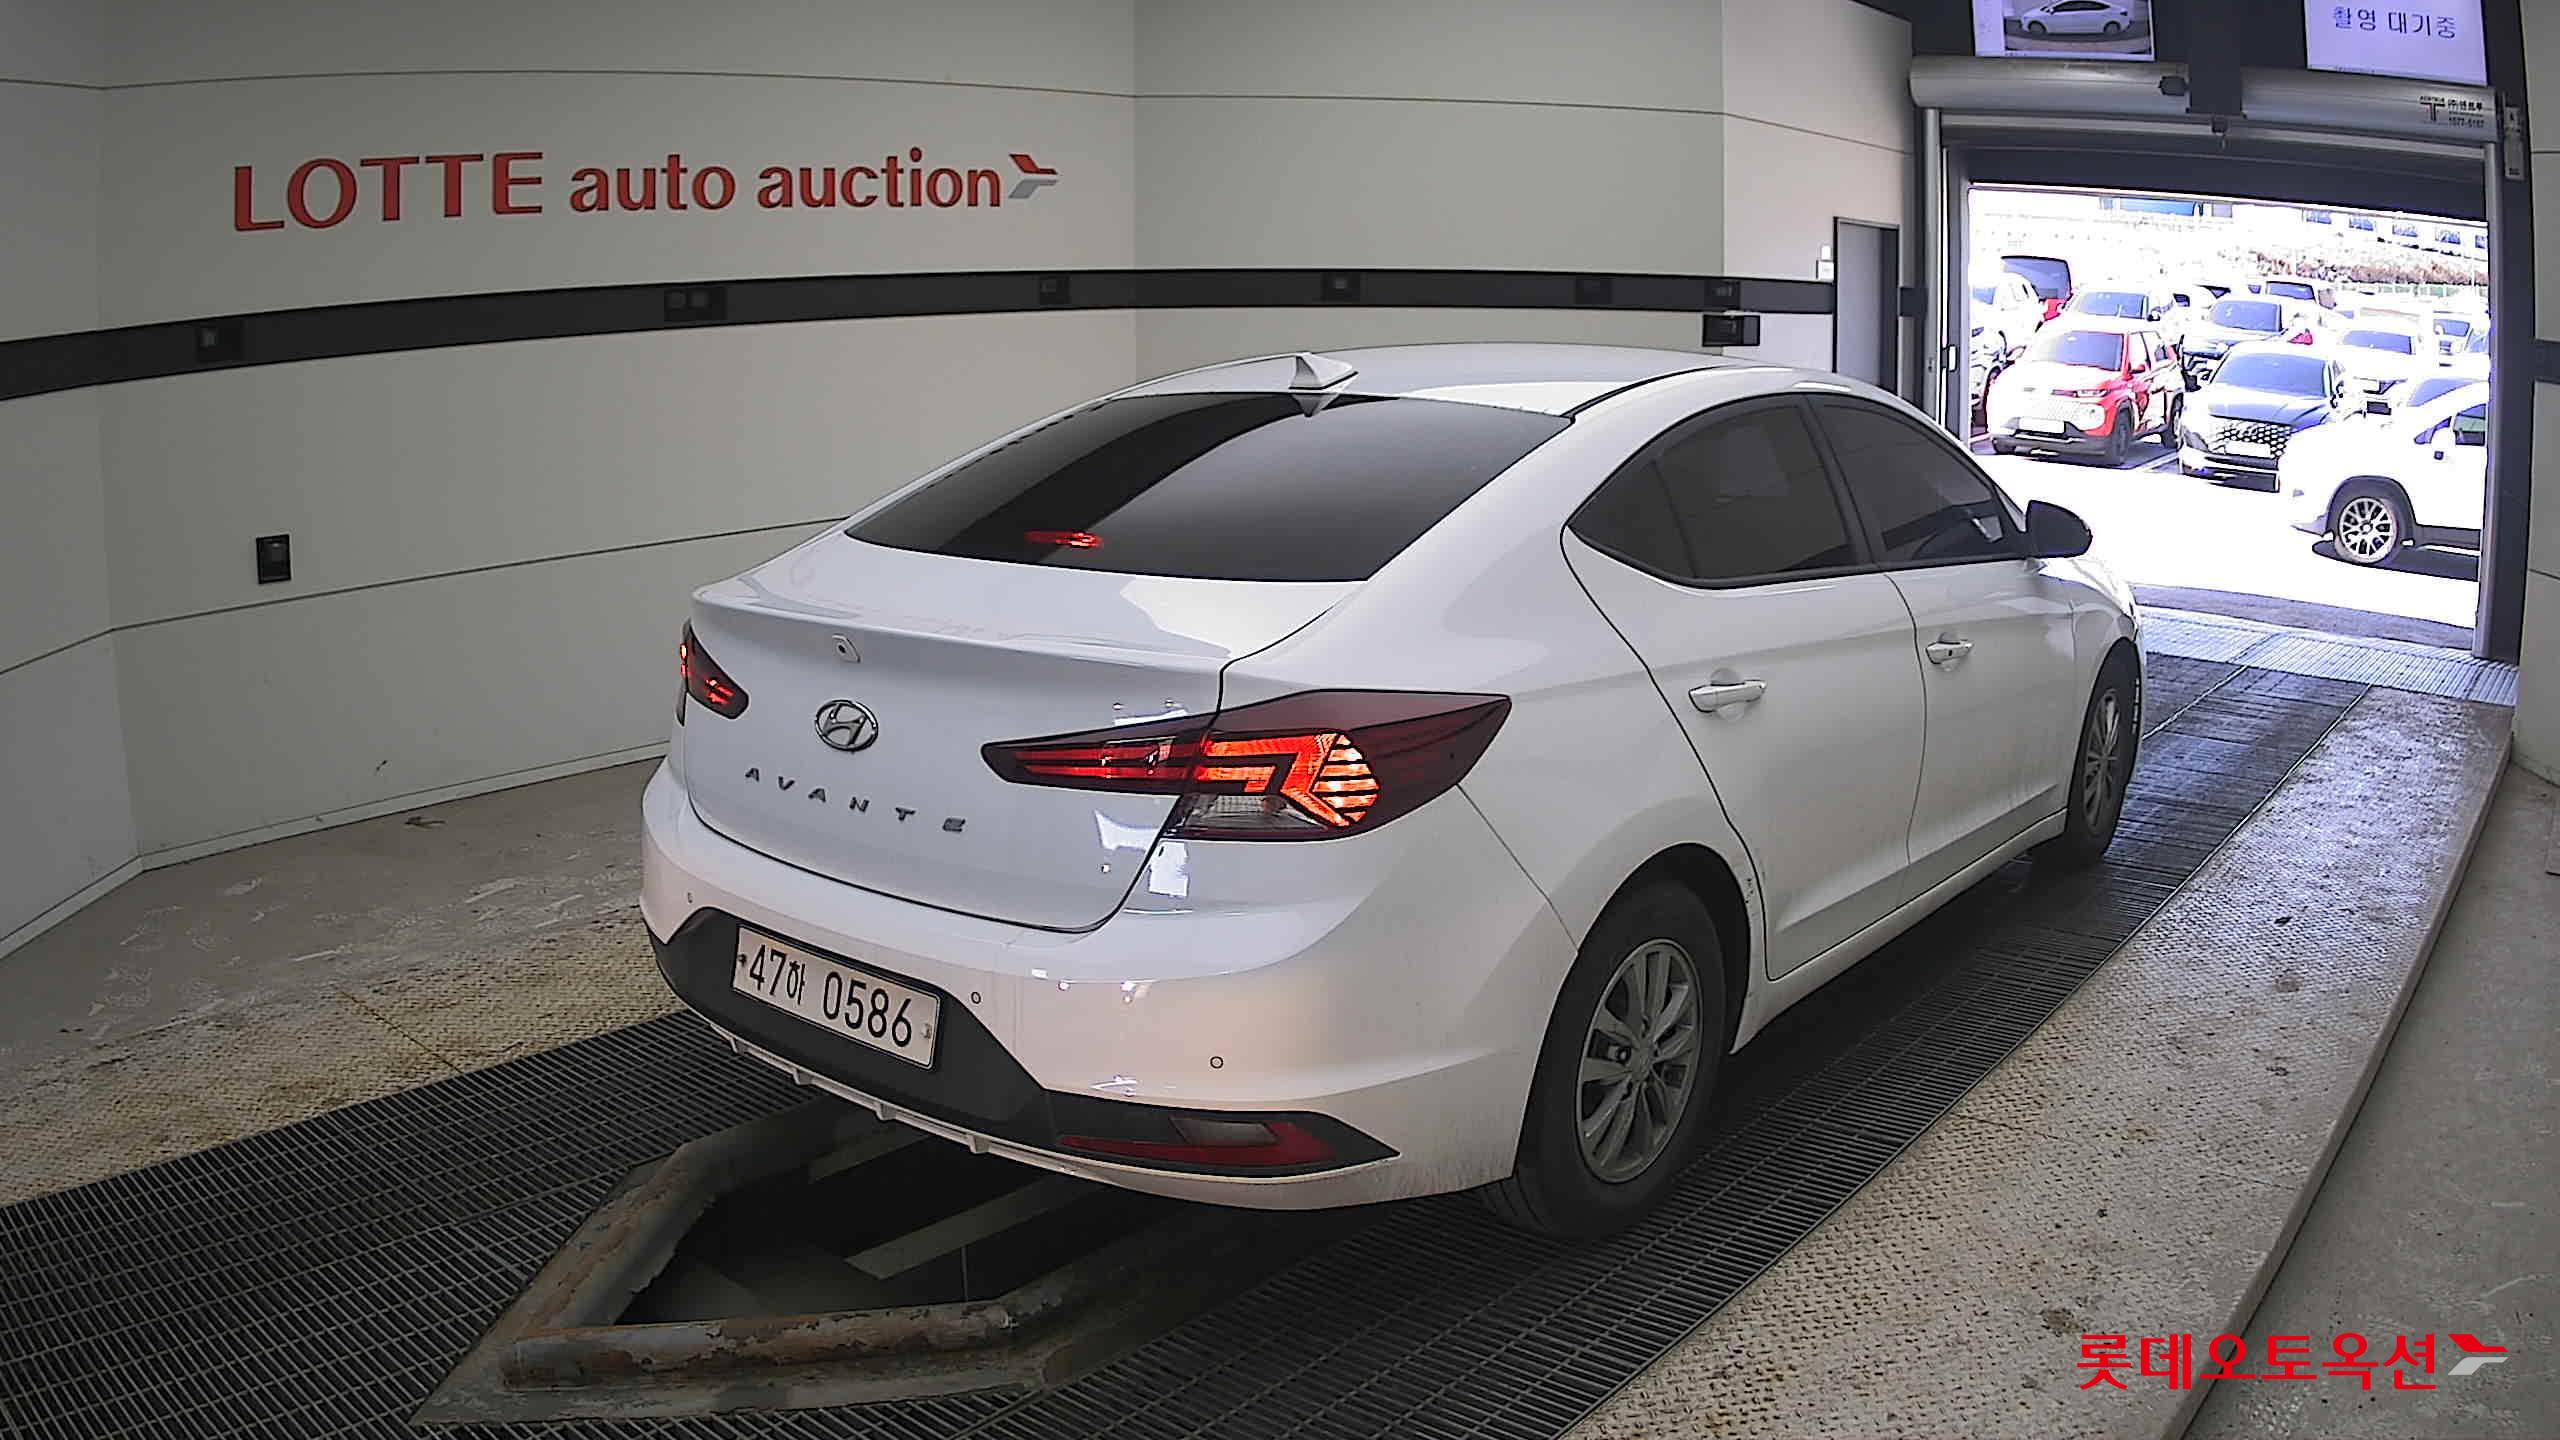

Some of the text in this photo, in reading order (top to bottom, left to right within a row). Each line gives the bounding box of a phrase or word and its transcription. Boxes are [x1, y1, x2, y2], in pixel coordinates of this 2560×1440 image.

[2334, 7, 2456, 39] 촬영 대기중
[234, 147, 1001, 232] LOTTE auto auction
[745, 767, 966, 833] AVANTE
[748, 944, 912, 1049] 47하 0586
